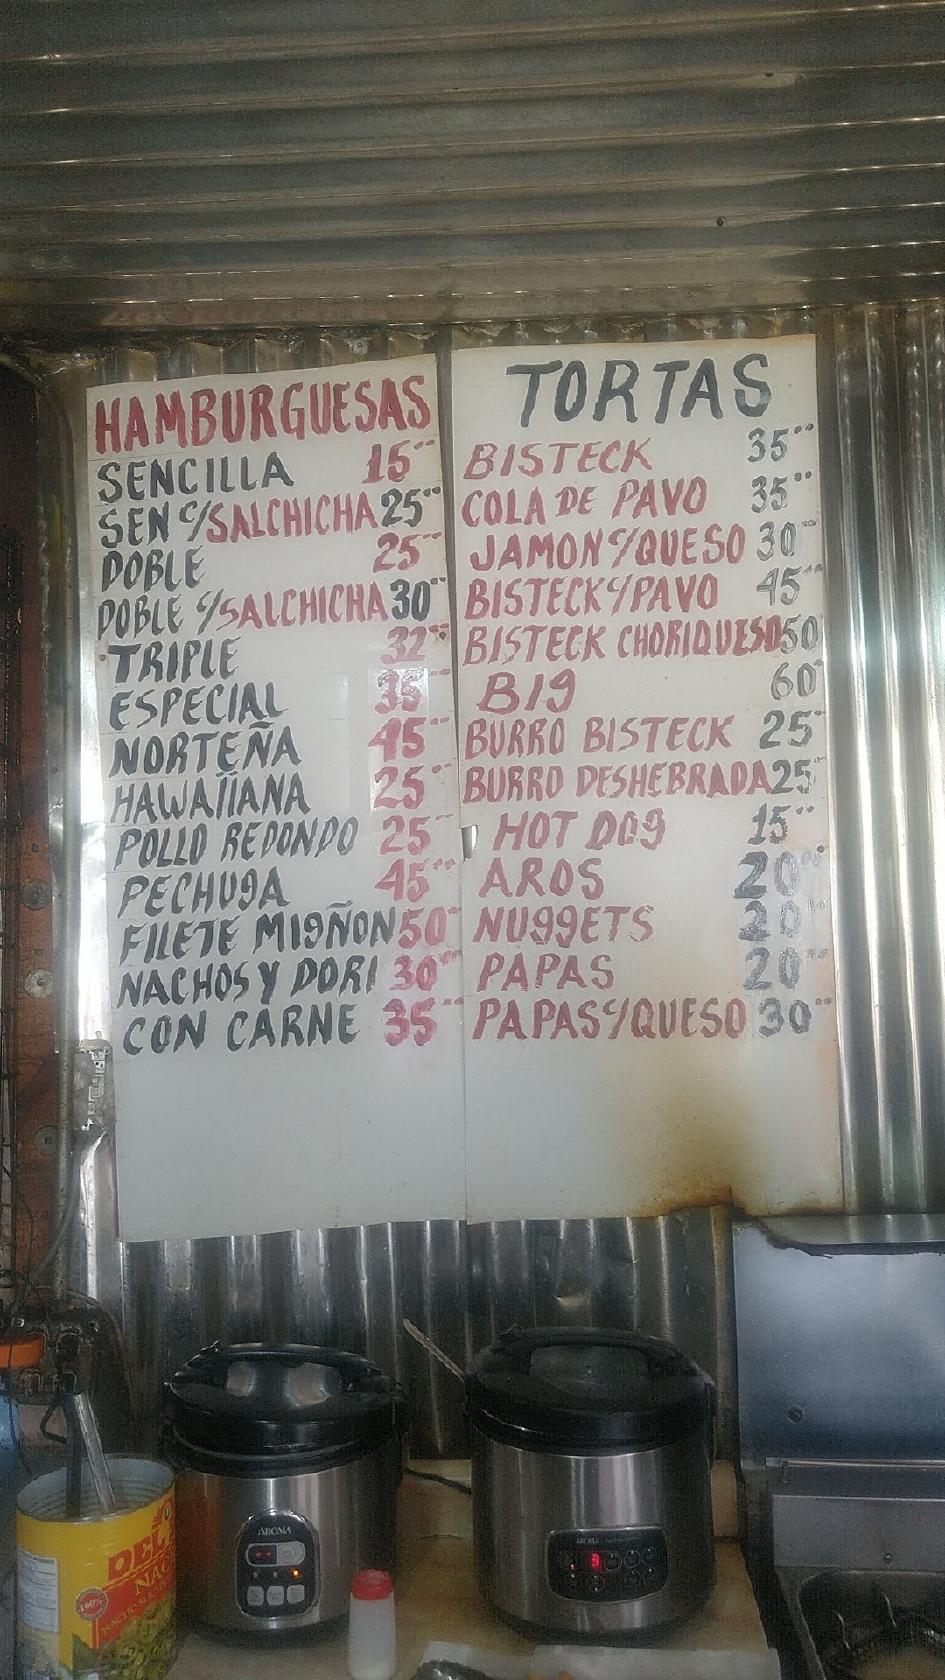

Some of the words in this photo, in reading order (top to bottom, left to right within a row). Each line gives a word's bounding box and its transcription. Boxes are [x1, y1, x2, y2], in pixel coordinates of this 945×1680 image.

[505, 353, 772, 428] TORTAS
[95, 375, 431, 454] HAMBURGUESAS
[97, 451, 294, 503] SENCILLA
[463, 436, 653, 480] BISTECK
[98, 501, 169, 548] SEN
[461, 486, 547, 528] COLA
[554, 486, 598, 518] DE
[611, 475, 708, 520] PAVO
[101, 546, 203, 593] DOBLE
[469, 527, 603, 571] JAMON
[98, 594, 184, 640] DOBLE
[464, 575, 605, 620] BISTECK
[108, 636, 241, 683] TRIPLE
[462, 624, 607, 666] BISTECK
[617, 614, 782, 659] CHORIQUESO
[109, 682, 289, 730] ESPECIAL
[109, 721, 302, 778] NORTEÑA
[464, 717, 566, 760] BURRO
[582, 714, 735, 753] BISTECK
[462, 765, 564, 804] BURRO
[576, 759, 773, 799] DESHEBRADA
[113, 822, 208, 871] POLLO
[220, 815, 359, 863] REDONDO
[492, 809, 578, 851] HOT
[478, 857, 605, 900] AROS
[119, 915, 241, 967] FILETE
[116, 960, 249, 1009] NACHOS
[257, 960, 281, 1004] Y
[290, 954, 378, 997] DORI
[476, 951, 615, 993] PAPAS
[122, 1009, 208, 1055] CON
[226, 1000, 361, 1052] CARNE
[472, 997, 601, 1040] PAPAS
